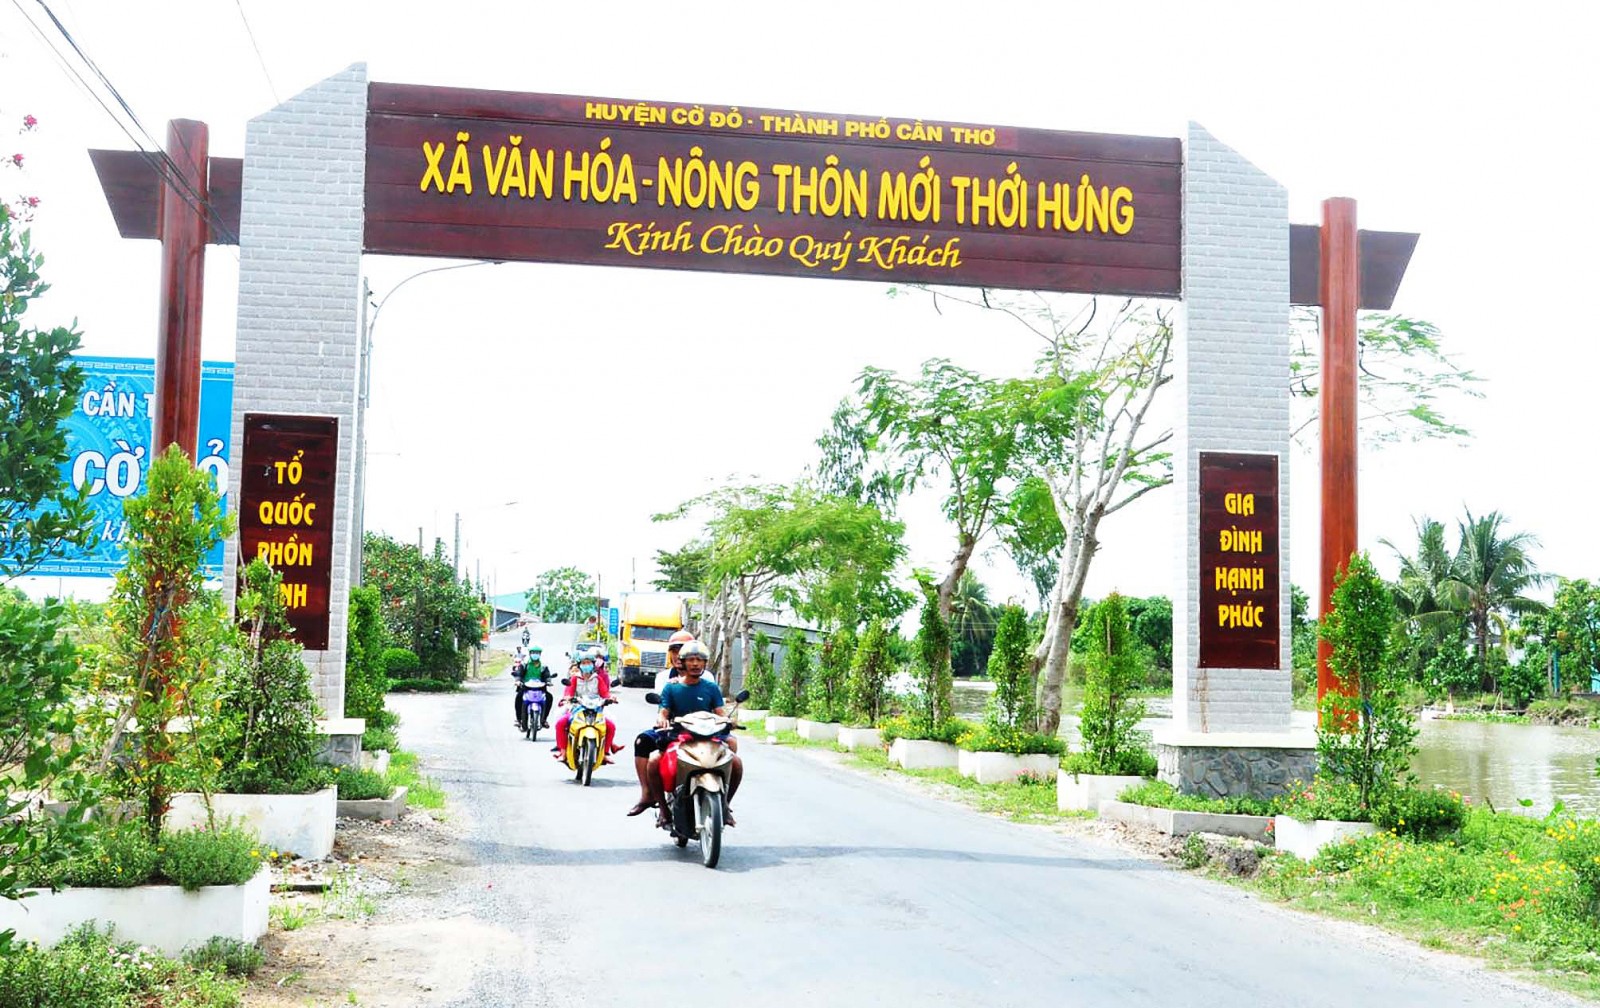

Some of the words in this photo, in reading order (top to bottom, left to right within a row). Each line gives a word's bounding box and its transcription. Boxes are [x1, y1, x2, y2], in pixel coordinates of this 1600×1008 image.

[585, 102, 667, 127] HUYỆN
[671, 105, 705, 126] CỜ
[709, 107, 743, 129] ĐỎ
[760, 114, 839, 136] THÀNH
[845, 117, 891, 139] PHỐ
[896, 119, 943, 142] CẦN
[951, 127, 996, 147] THƠ
[420, 131, 473, 195] XÃ
[482, 134, 555, 199] VĂN
[771, 154, 868, 219] THÔN
[877, 155, 941, 223] MỚI
[950, 162, 1029, 229] THỚI
[1036, 173, 1135, 236] HƯNG
[604, 221, 695, 256] Kính
[700, 223, 784, 257] Chào
[788, 231, 853, 272] Quý
[857, 234, 962, 270] Khách
[83, 381, 135, 417] CẦN
[72, 440, 146, 497] CỜ
[274, 450, 304, 485] TỔ
[259, 493, 316, 526] QUỐC
[1224, 493, 1255, 516] GIA
[257, 533, 313, 566] PHỒN
[1219, 525, 1263, 554] ĐÌNH
[1215, 567, 1264, 596] HẠNH
[1218, 600, 1264, 629] PHÚC
